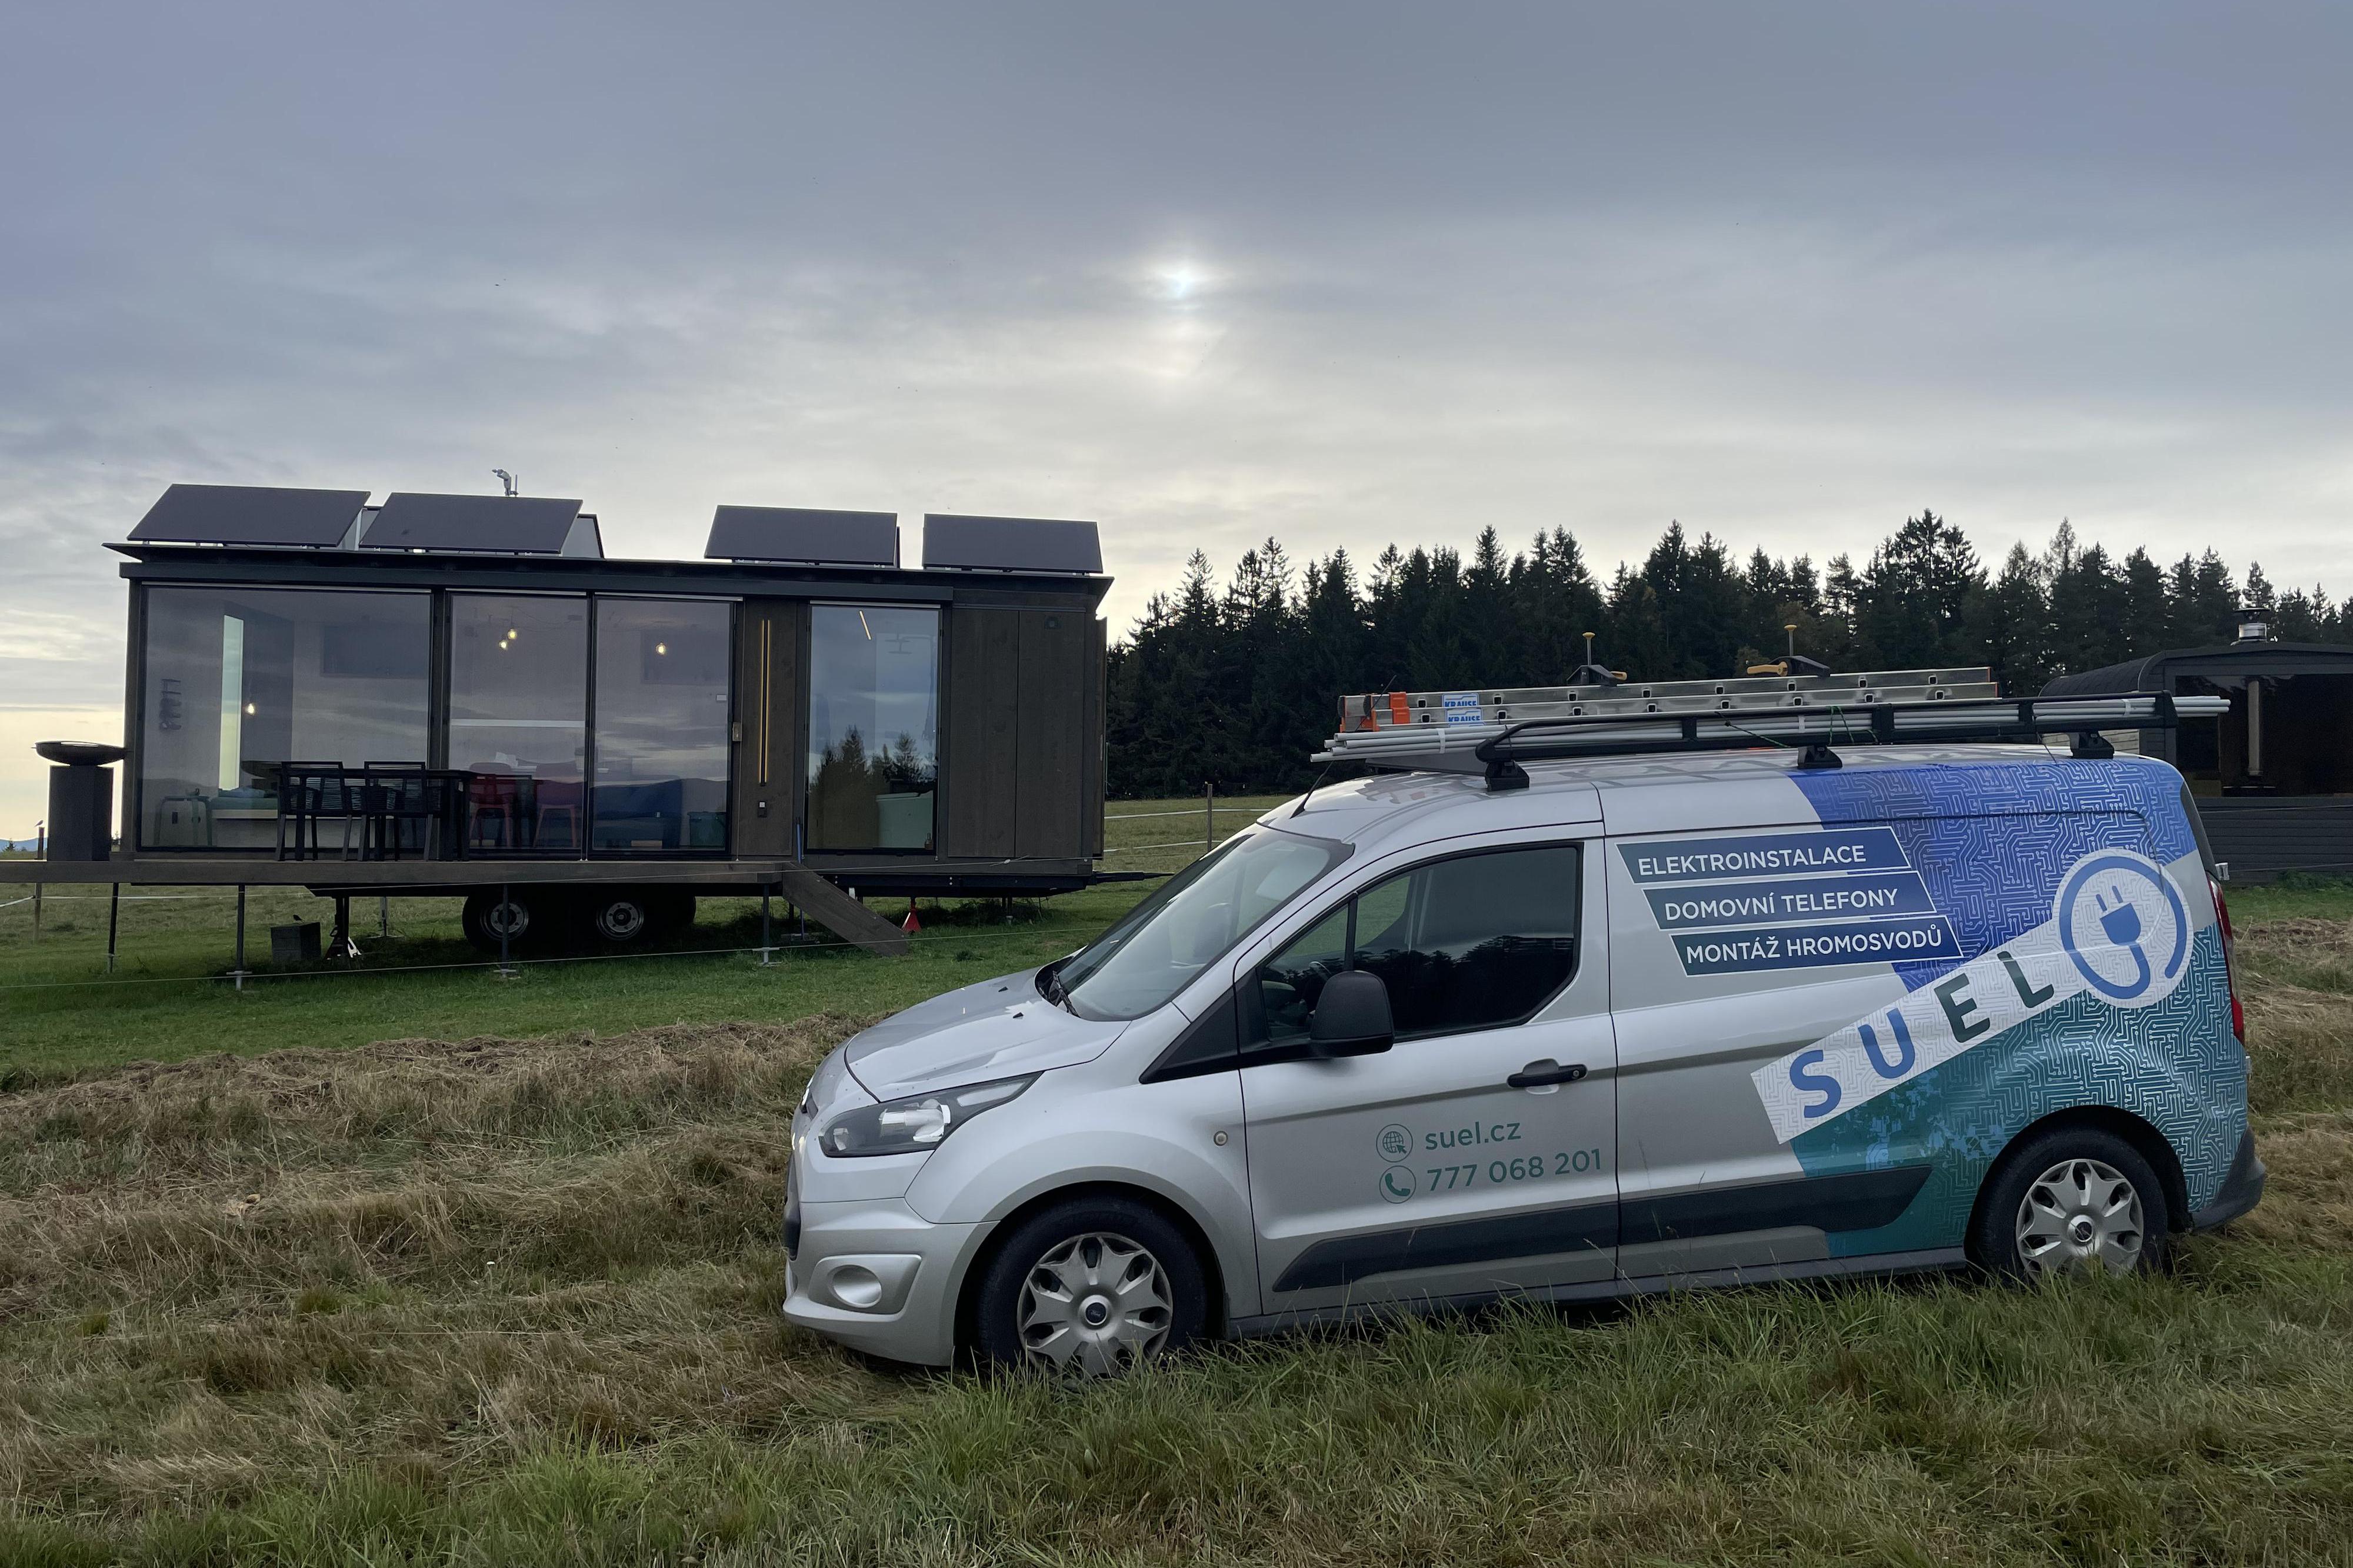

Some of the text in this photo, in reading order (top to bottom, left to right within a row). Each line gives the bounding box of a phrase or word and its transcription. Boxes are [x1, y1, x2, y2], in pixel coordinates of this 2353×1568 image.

[1638, 845, 1866, 876] ELEKTROINSTALACE
[1665, 888, 1898, 921] DOMOVNÍ TELEFONY
[1687, 924, 1942, 964] MONTÁŽ HROMOSVODŮ
[1789, 950, 2054, 1118] SUEL
[1425, 1122, 1521, 1150] suel.cz
[1427, 1148, 1601, 1191] 777 068 201
